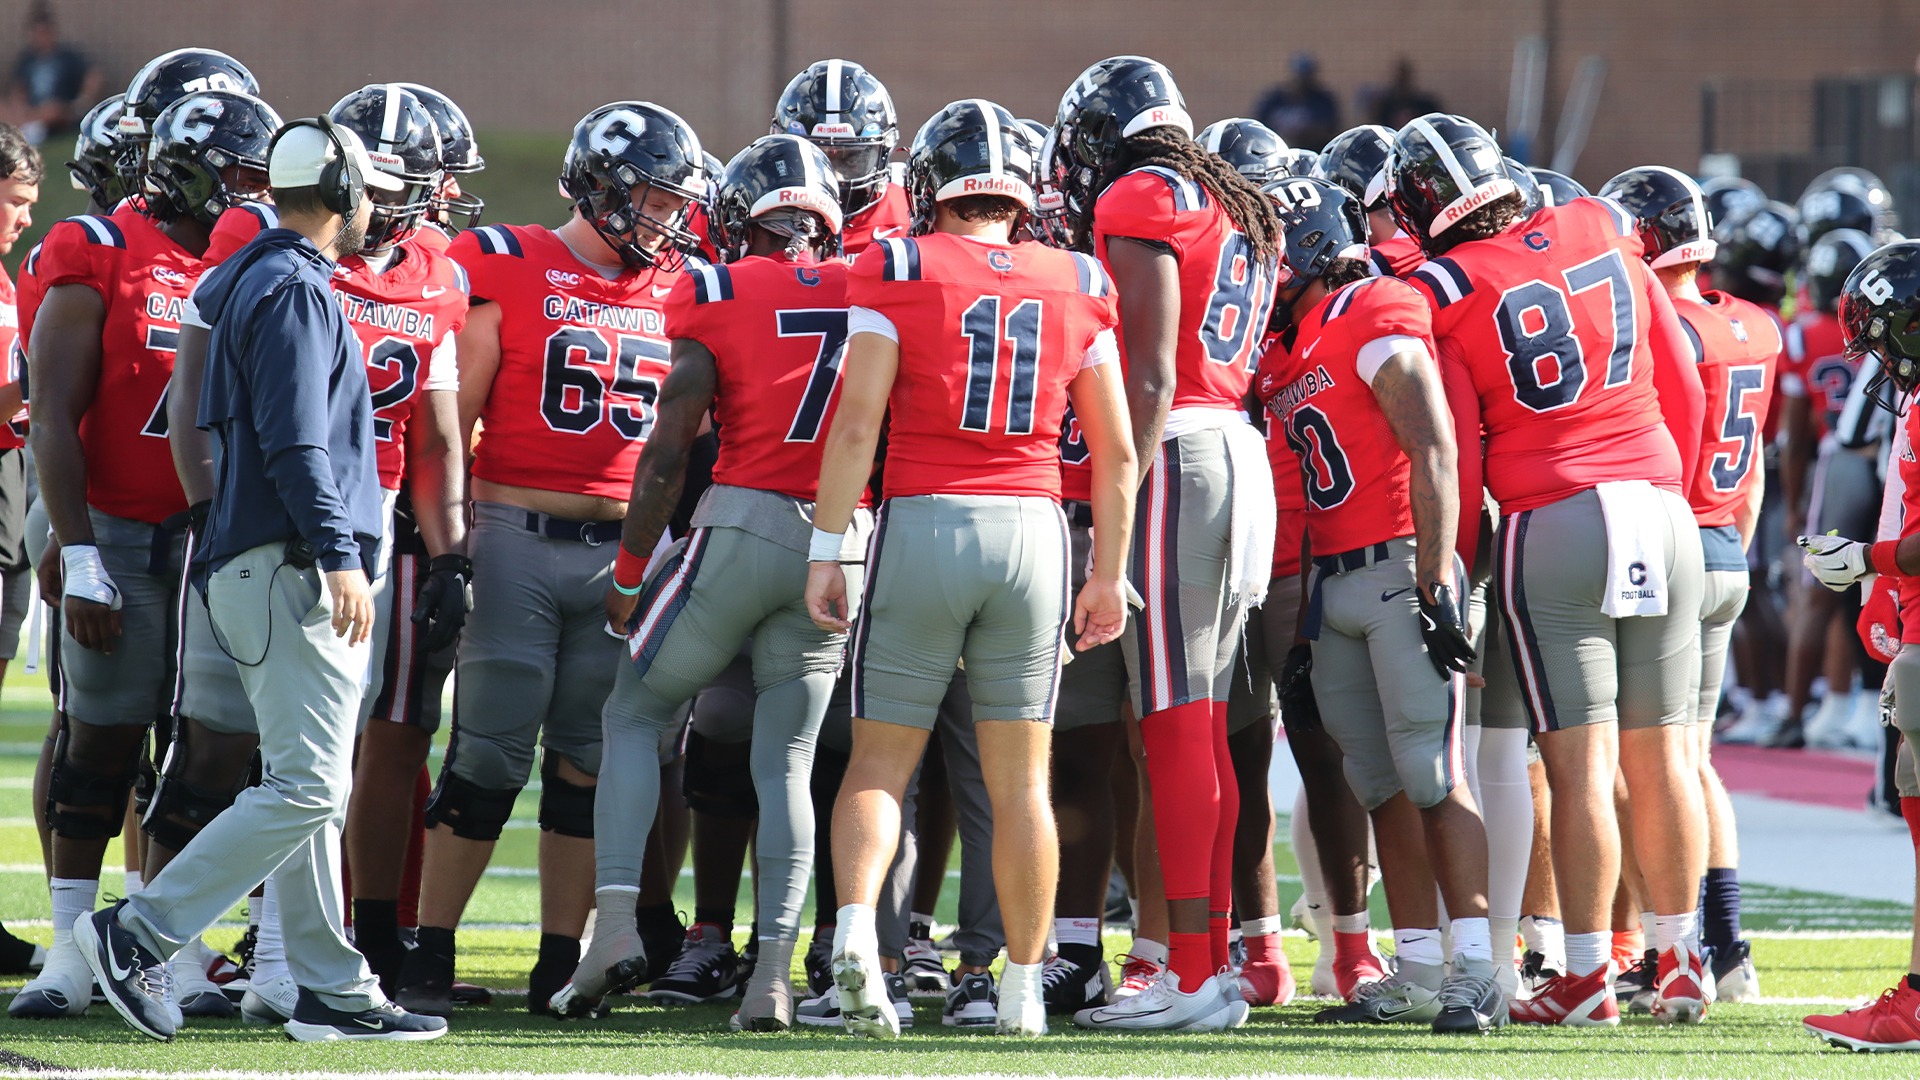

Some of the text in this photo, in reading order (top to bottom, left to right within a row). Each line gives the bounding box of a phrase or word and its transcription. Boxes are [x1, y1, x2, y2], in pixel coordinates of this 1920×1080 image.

[170, 98, 225, 145] C
[589, 110, 646, 155] C
[964, 178, 1022, 195] Riddell
[1445, 184, 1500, 221] Riddell
[1522, 231, 1550, 251] C
[551, 269, 580, 286] SAC
[795, 267, 821, 287] C
[988, 251, 1013, 272] C
[1859, 269, 1894, 306] 6
[146, 291, 189, 324] CA
[332, 288, 434, 342] ATAWBA
[543, 294, 666, 335] CATAWB
[1492, 248, 1637, 413] 87
[540, 325, 672, 441] 65
[775, 308, 849, 442] 7
[959, 294, 1043, 435] 11
[352, 330, 420, 442] 2
[1709, 364, 1765, 492] 5
[1628, 560, 1648, 587] C
[1621, 589, 1656, 600] FOOTBALL
